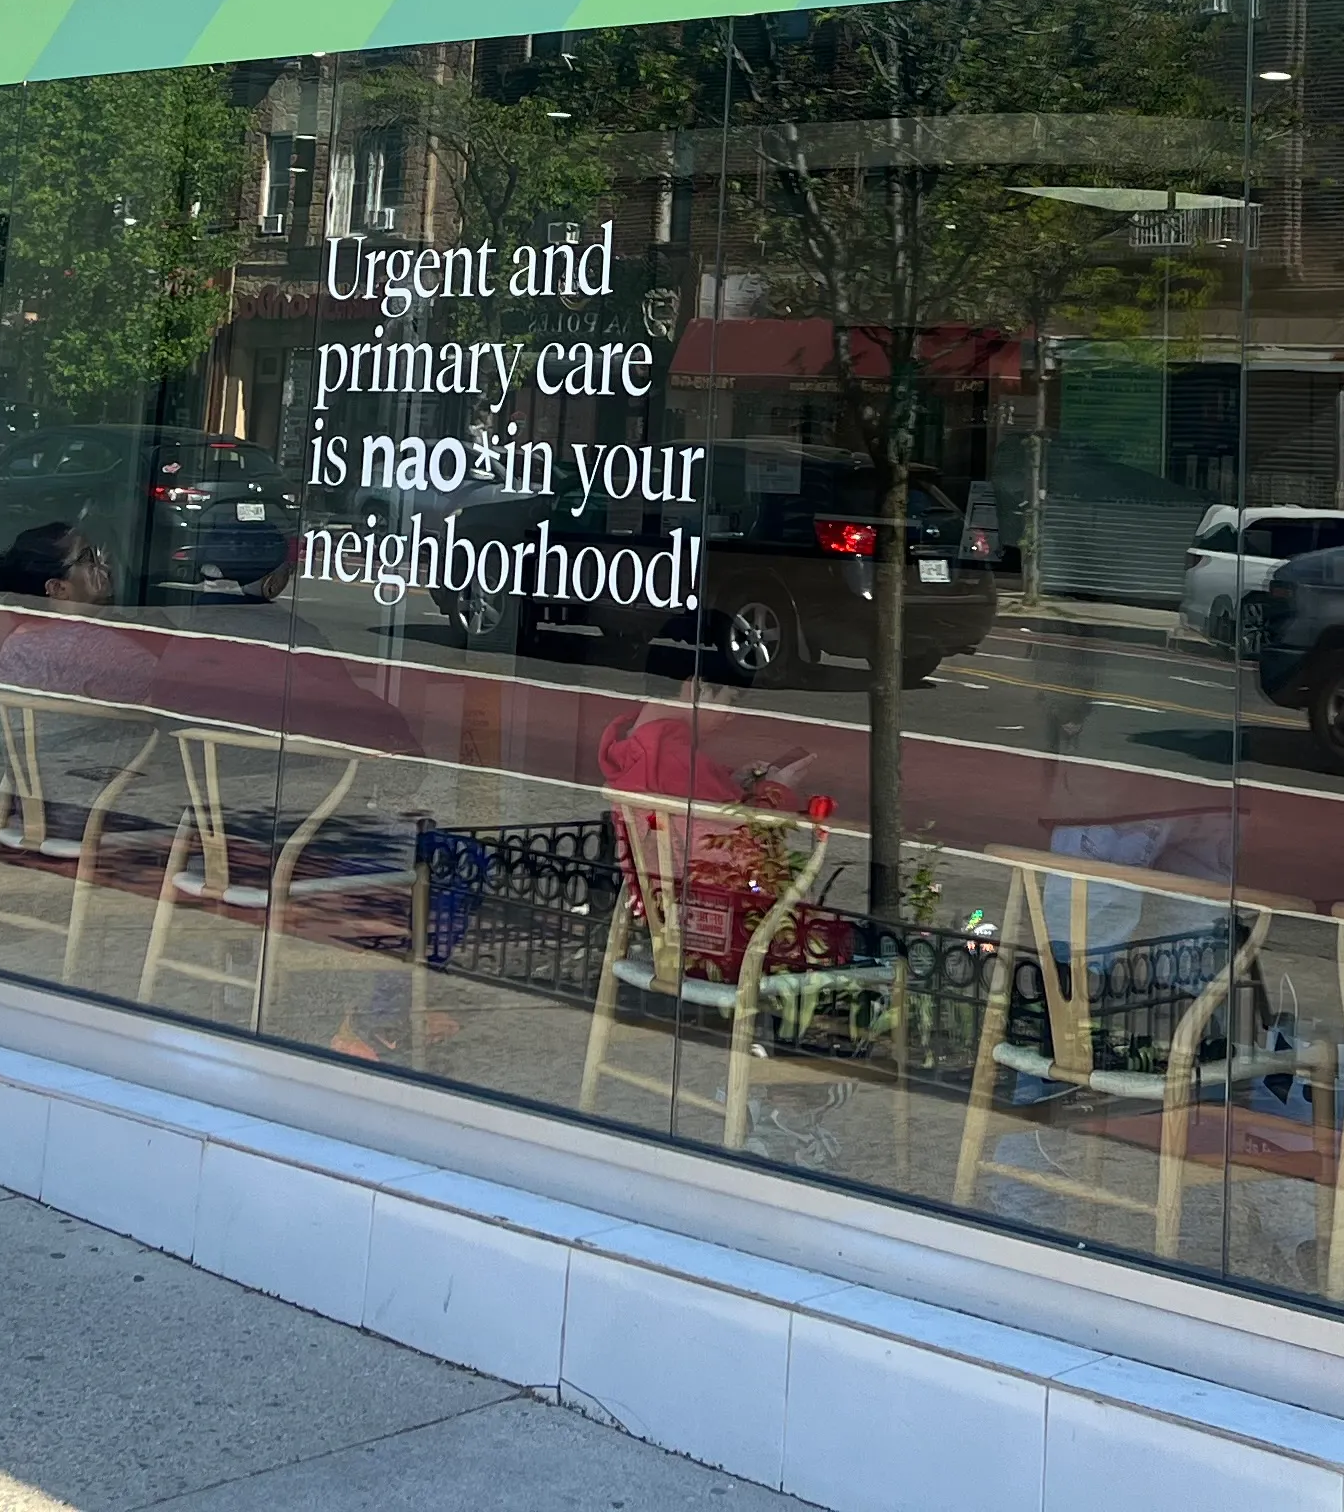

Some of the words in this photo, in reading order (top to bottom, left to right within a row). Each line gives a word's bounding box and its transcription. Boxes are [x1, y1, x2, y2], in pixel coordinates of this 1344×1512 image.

[326, 236, 496, 318] Urgent
[509, 220, 614, 298] and
[313, 325, 524, 414] primary
[536, 341, 653, 397] care
[308, 417, 347, 488] is
[571, 441, 705, 517] your
[300, 513, 702, 612] neighborhood!
